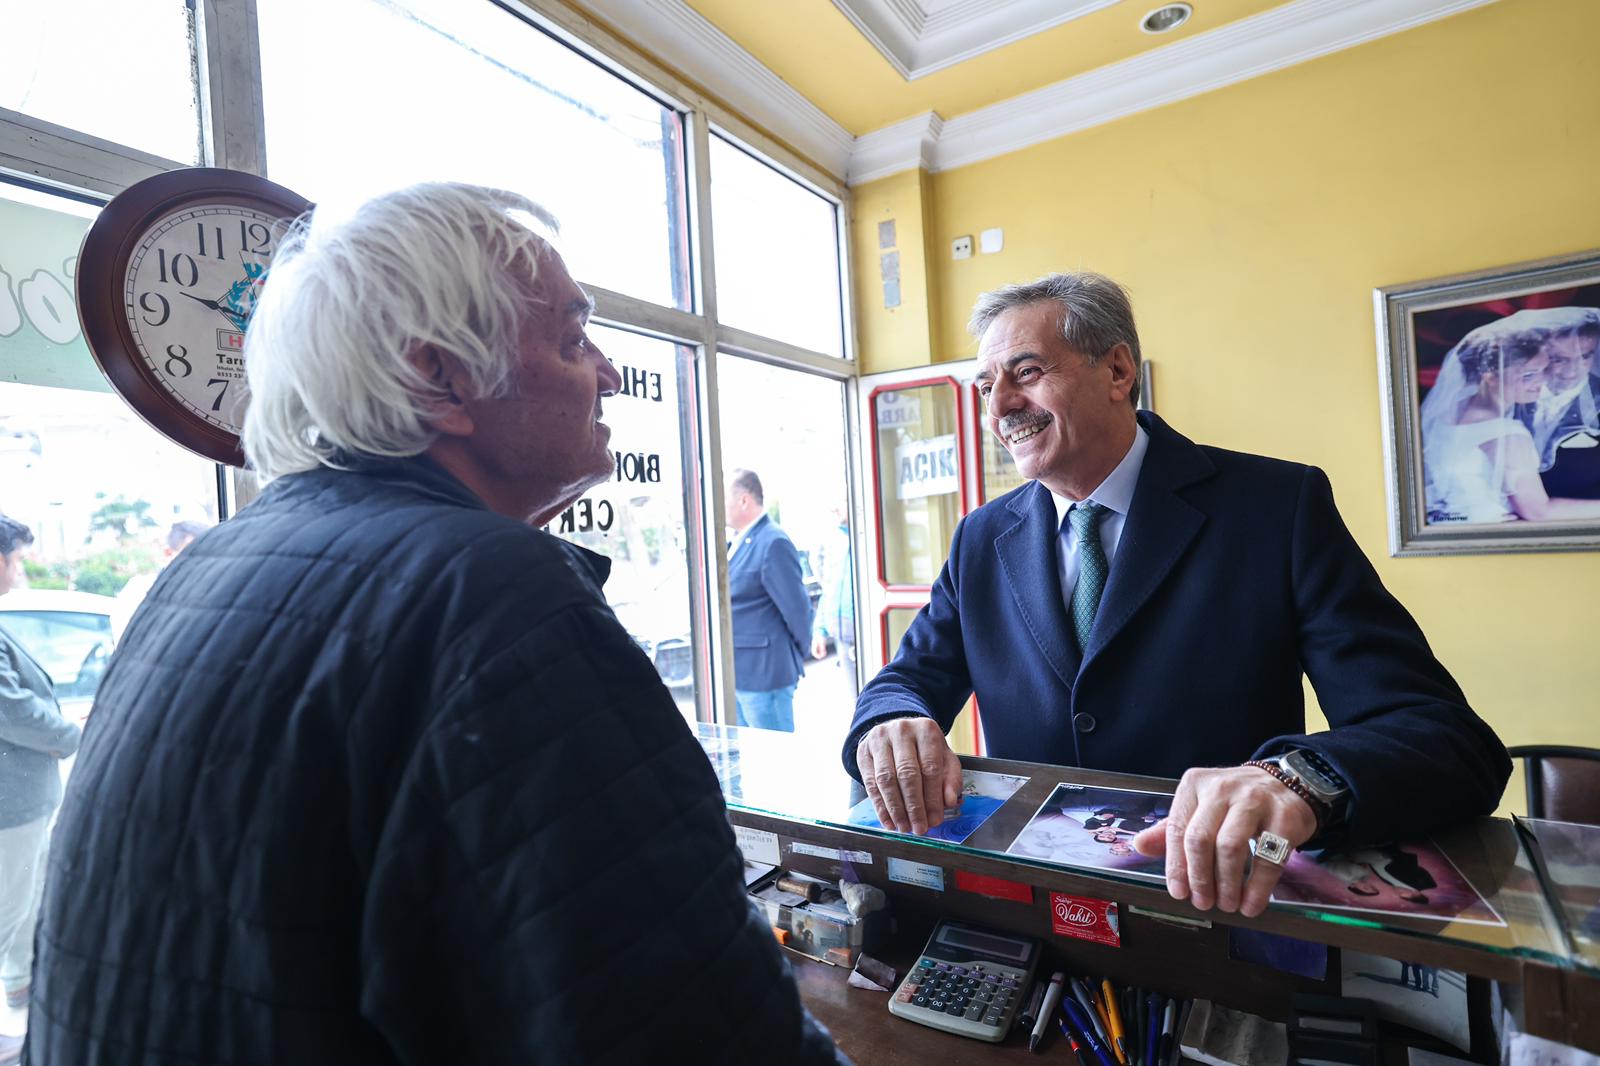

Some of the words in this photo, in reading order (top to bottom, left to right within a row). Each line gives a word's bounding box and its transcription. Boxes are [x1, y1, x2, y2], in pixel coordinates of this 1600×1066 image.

[197, 222, 225, 260] 11
[240, 220, 272, 256] 12
[158, 248, 199, 287] 10
[139, 291, 170, 327] 9
[164, 344, 193, 378] 8
[216, 353, 246, 366] Tarı
[206, 378, 230, 412] 7
